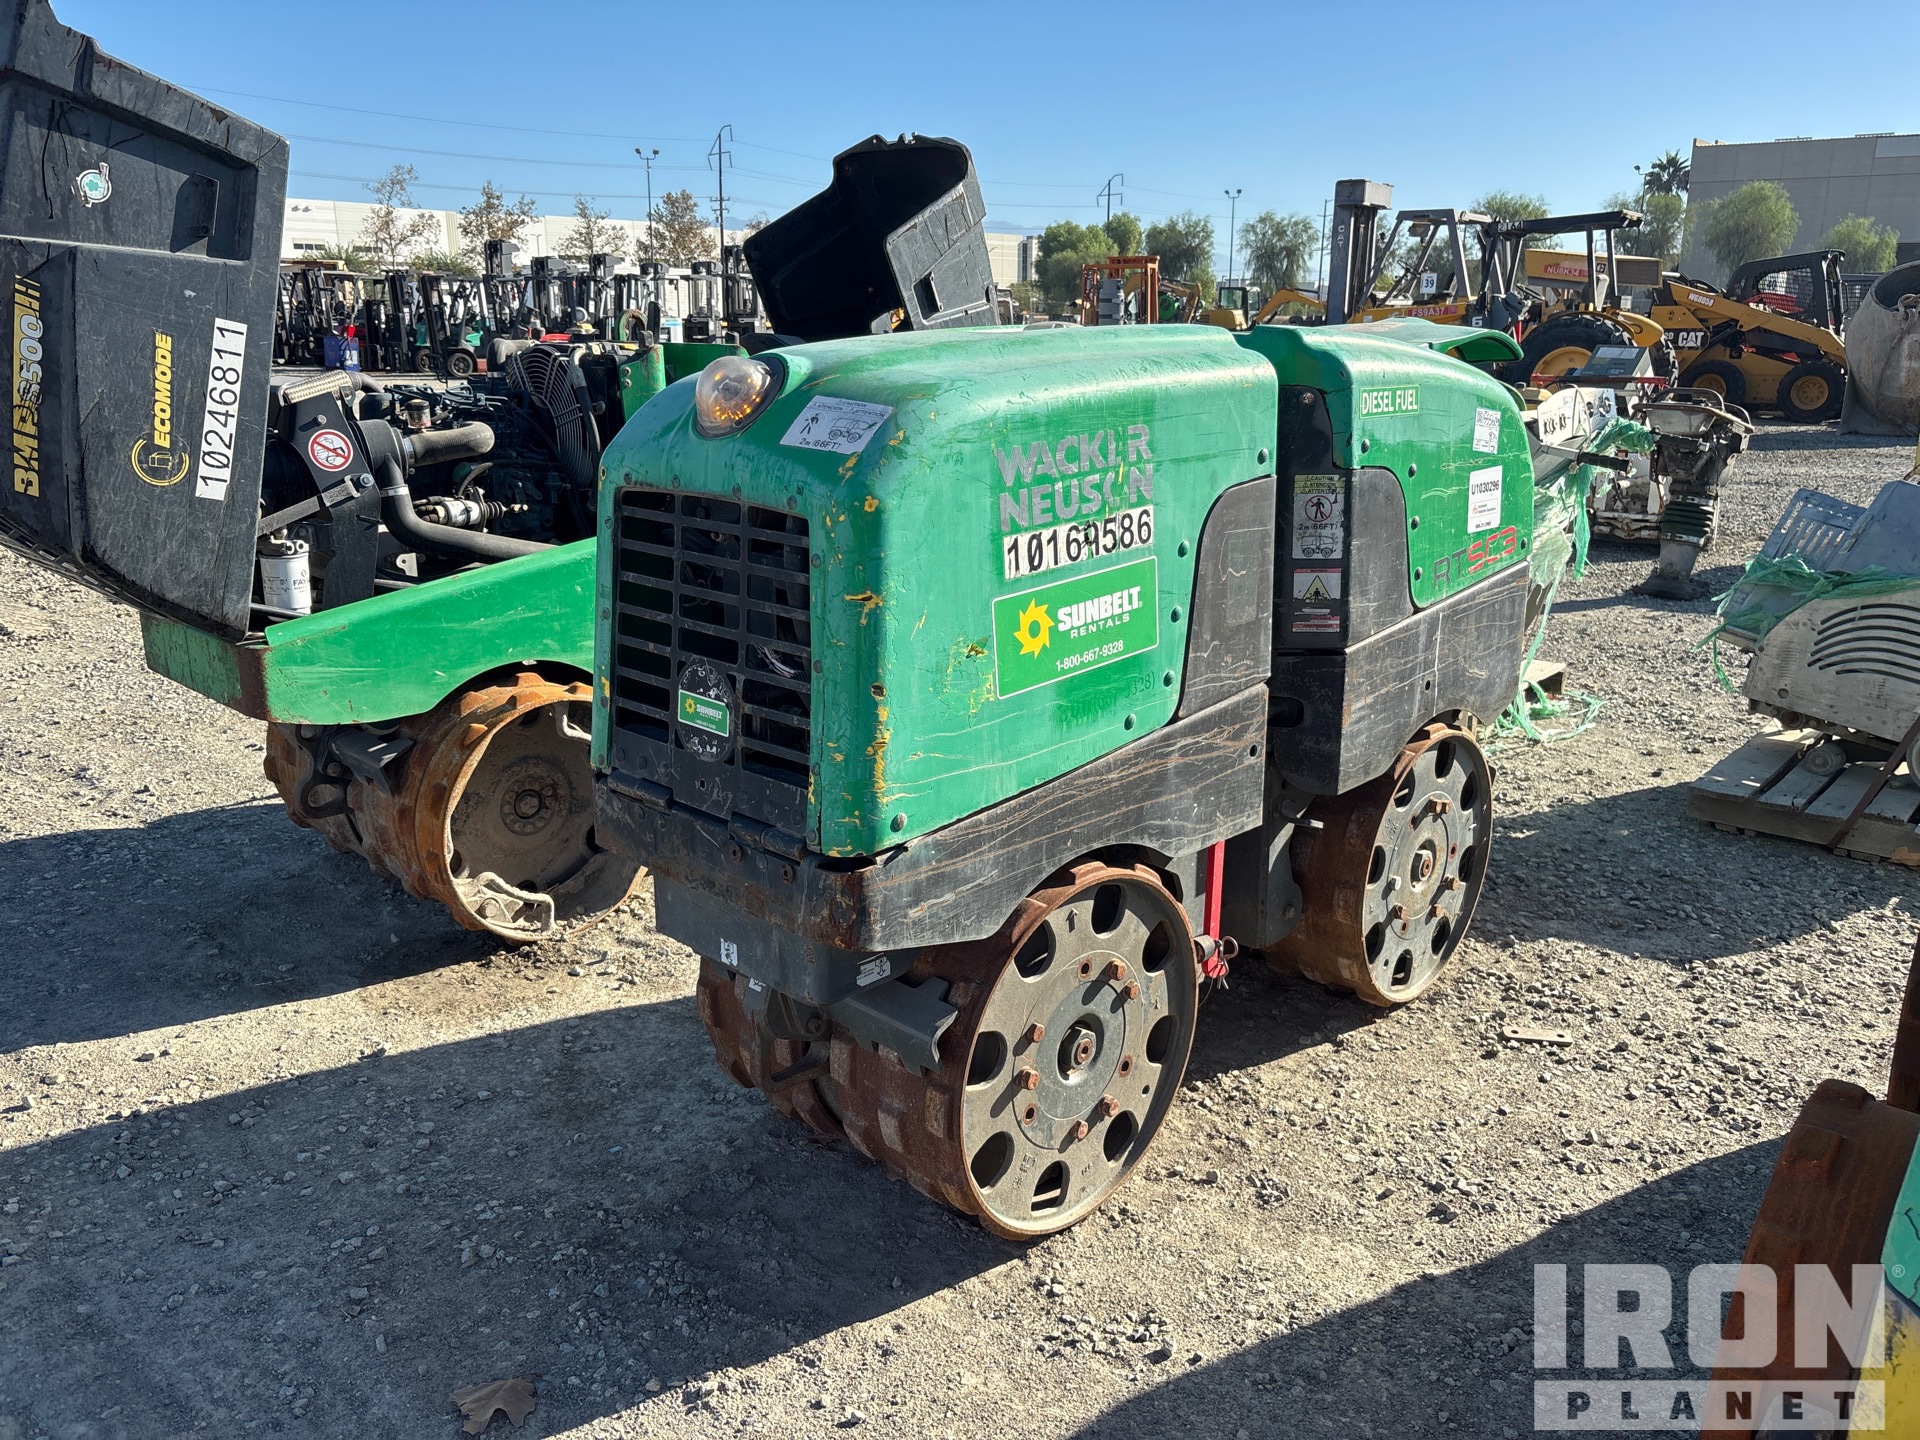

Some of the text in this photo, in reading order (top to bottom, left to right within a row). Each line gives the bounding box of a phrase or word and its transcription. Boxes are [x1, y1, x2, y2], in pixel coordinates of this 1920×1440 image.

[1337, 225, 1346, 248] CAT
[1424, 278, 1435, 289] 39
[1412, 306, 1445, 317] FS9A37
[1471, 316, 1483, 327] 6
[1677, 331, 1705, 347] CAT
[153, 331, 173, 449] ECOMODE
[1361, 389, 1418, 415] DIESEL FUEL
[199, 326, 245, 487] 10246811
[1007, 509, 1152, 573] 10169586
[1057, 586, 1141, 632] SUNBELT
[1070, 613, 1130, 639] RENTALS
[1055, 640, 1124, 672] 1-800-667-9328
[696, 704, 723, 719] SUNBELT
